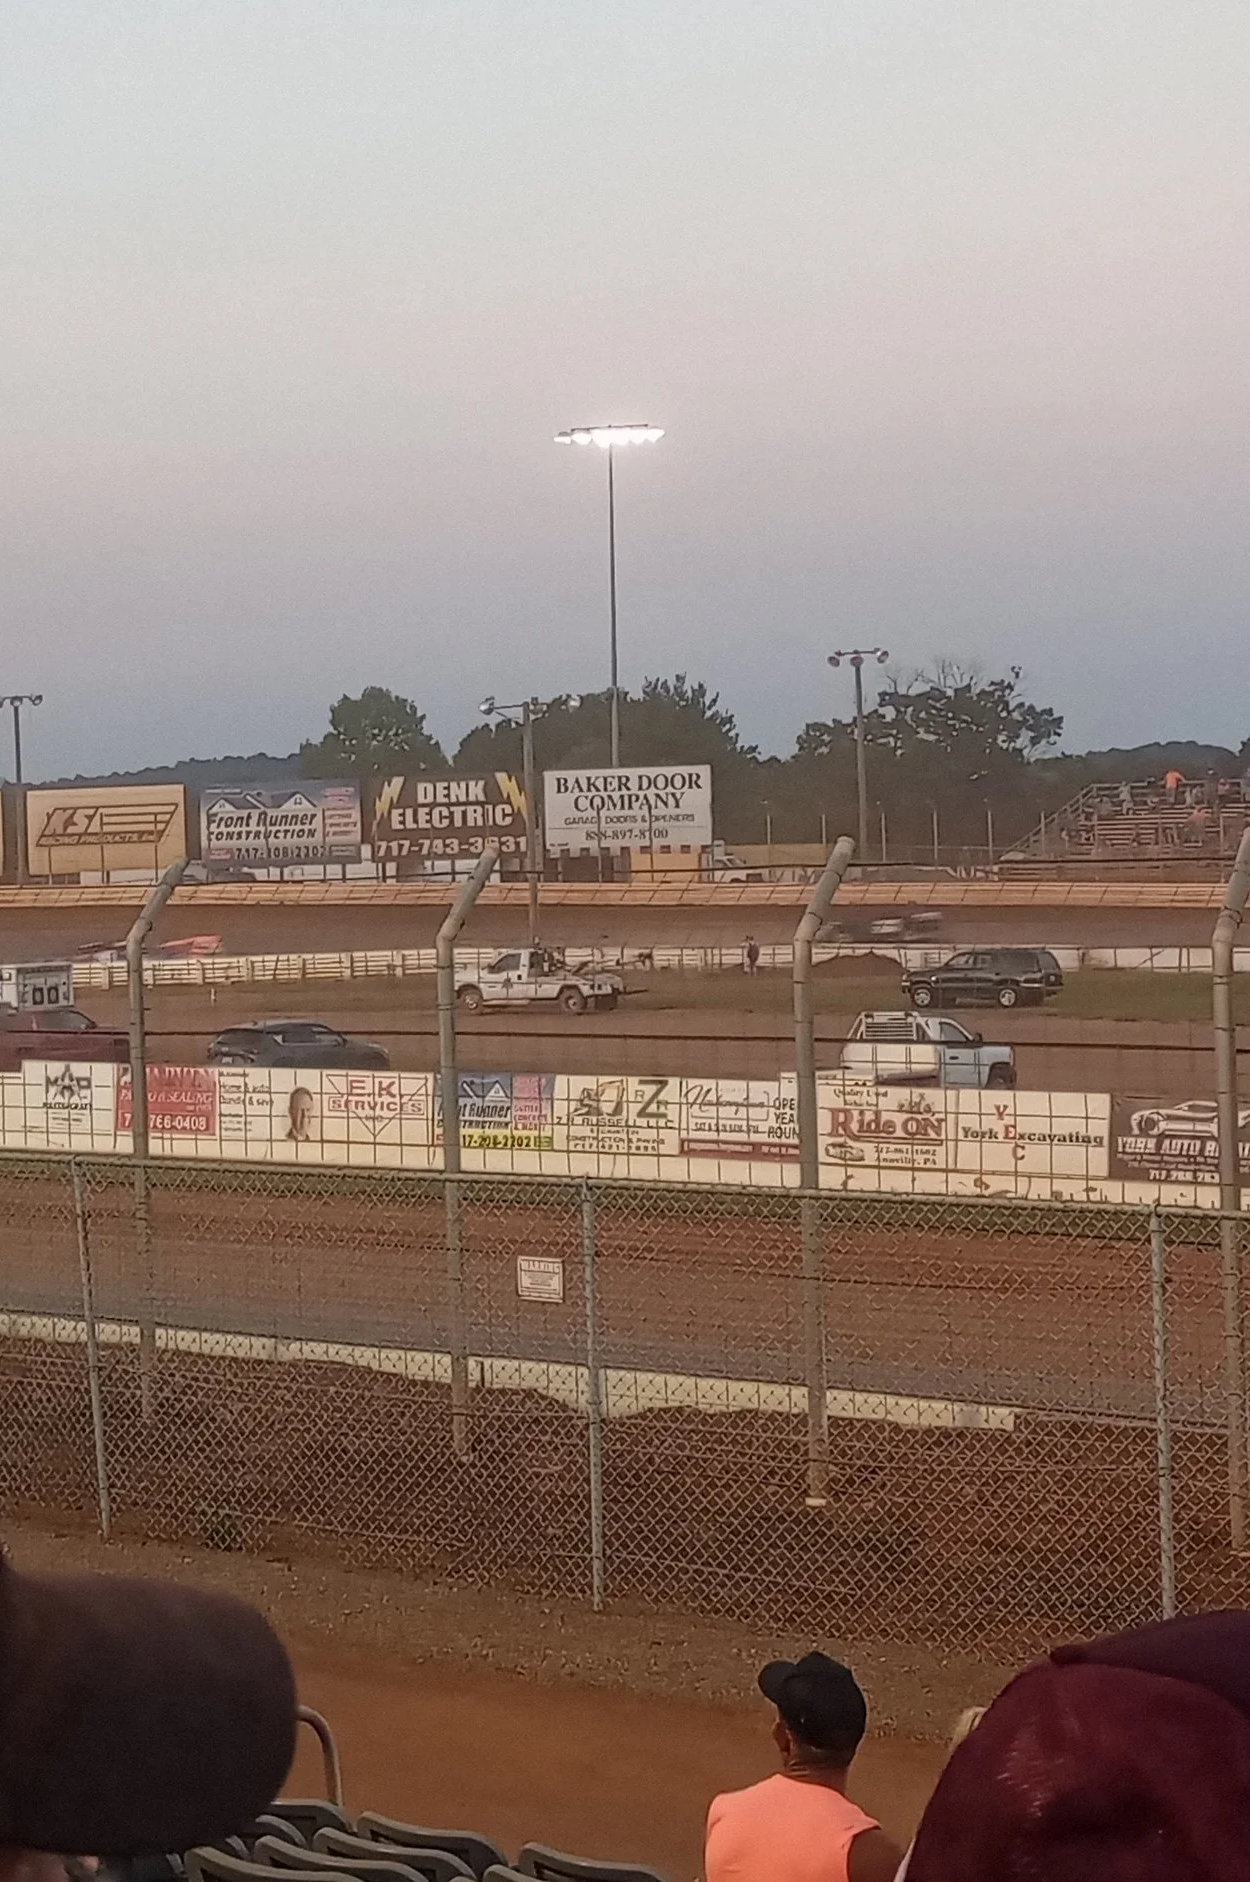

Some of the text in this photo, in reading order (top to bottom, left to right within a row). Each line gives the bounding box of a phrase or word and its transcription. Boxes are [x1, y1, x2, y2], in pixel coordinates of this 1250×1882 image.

[417, 780, 486, 803] DENK
[555, 772, 703, 794] BAKER DOOR
[573, 792, 685, 812] COMPANY
[208, 812, 252, 829] Front
[391, 804, 513, 830] ELECTRIC
[564, 815, 599, 825] GARAG
[605, 814, 638, 824] DOORS
[651, 813, 695, 823] OPENERS
[209, 828, 317, 841] CONSTRUCTION
[331, 1097, 423, 1114] SERVICES
[468, 1102, 511, 1118] Runner
[773, 1097, 796, 1111] OPE
[774, 1111, 795, 1125] YEA
[828, 1107, 897, 1138] Ride
[767, 1125, 799, 1139] ROUN
[961, 1124, 1105, 1146] York Excavating
[1160, 1138, 1202, 1156] AUTO
